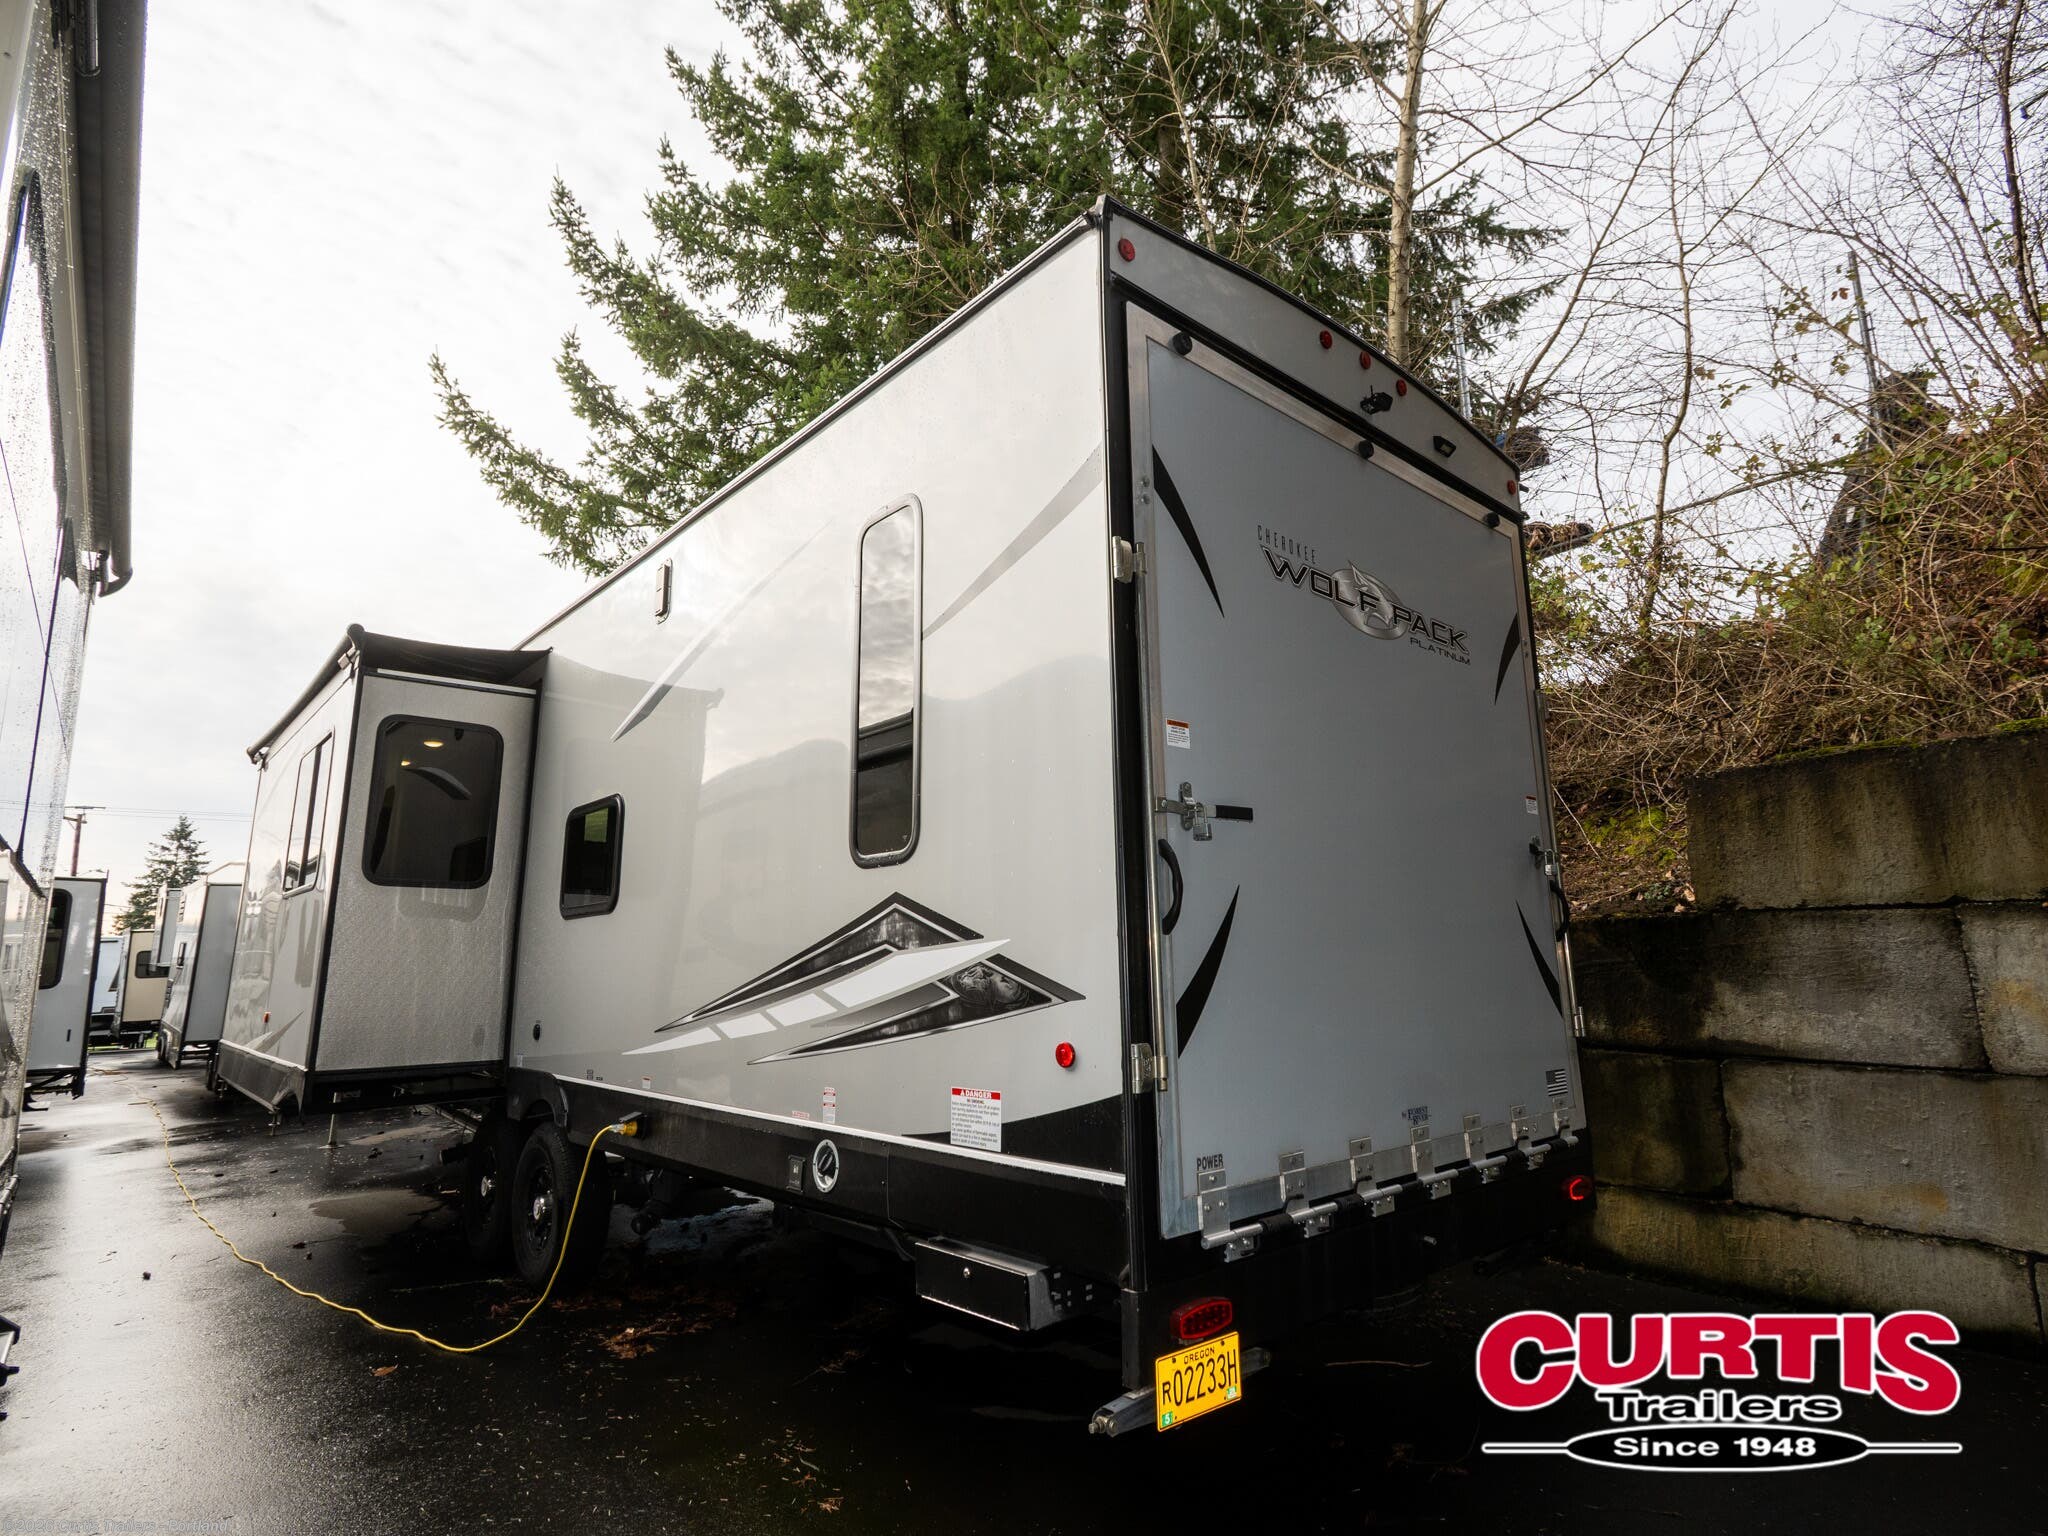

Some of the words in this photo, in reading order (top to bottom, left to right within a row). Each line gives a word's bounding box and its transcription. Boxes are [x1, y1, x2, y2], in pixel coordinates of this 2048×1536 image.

[1257, 525, 1316, 565] CHEROKEE
[1259, 544, 1381, 613] WOLF
[1392, 602, 1470, 655] PACK
[1410, 637, 1471, 666] PLATINUM
[965, 1090, 992, 1099] DANGER
[1196, 1153, 1224, 1171] POWER
[1184, 1347, 1215, 1364] OREGON
[1162, 1349, 1238, 1407] R02233H
